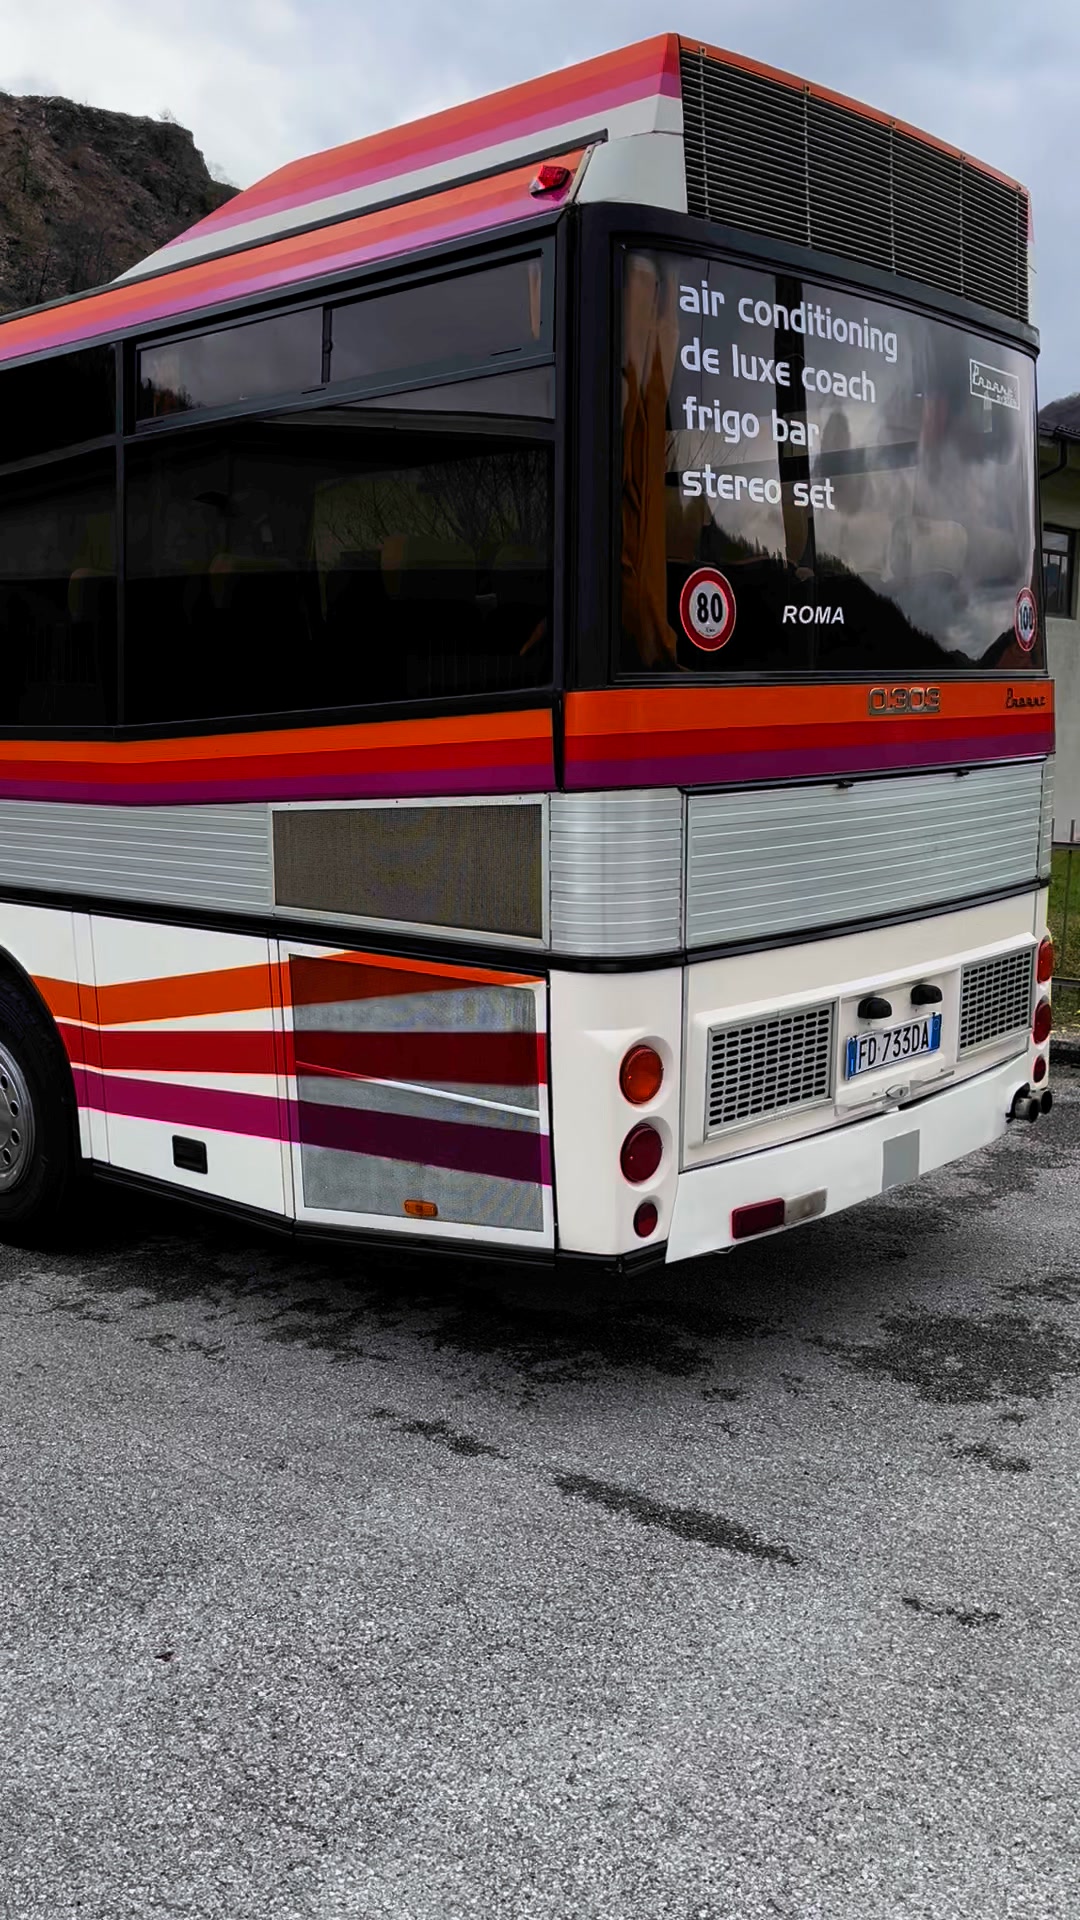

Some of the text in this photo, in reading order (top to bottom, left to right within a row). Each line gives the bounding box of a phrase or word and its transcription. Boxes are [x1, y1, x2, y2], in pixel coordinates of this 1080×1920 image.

[679, 280, 898, 363] air conditioning
[680, 336, 876, 403] de luxe coach
[682, 395, 819, 448] frigo bar
[682, 463, 836, 510] stereo set
[696, 592, 723, 623] 80
[782, 605, 845, 625] ROMA
[1020, 605, 1034, 631] 100
